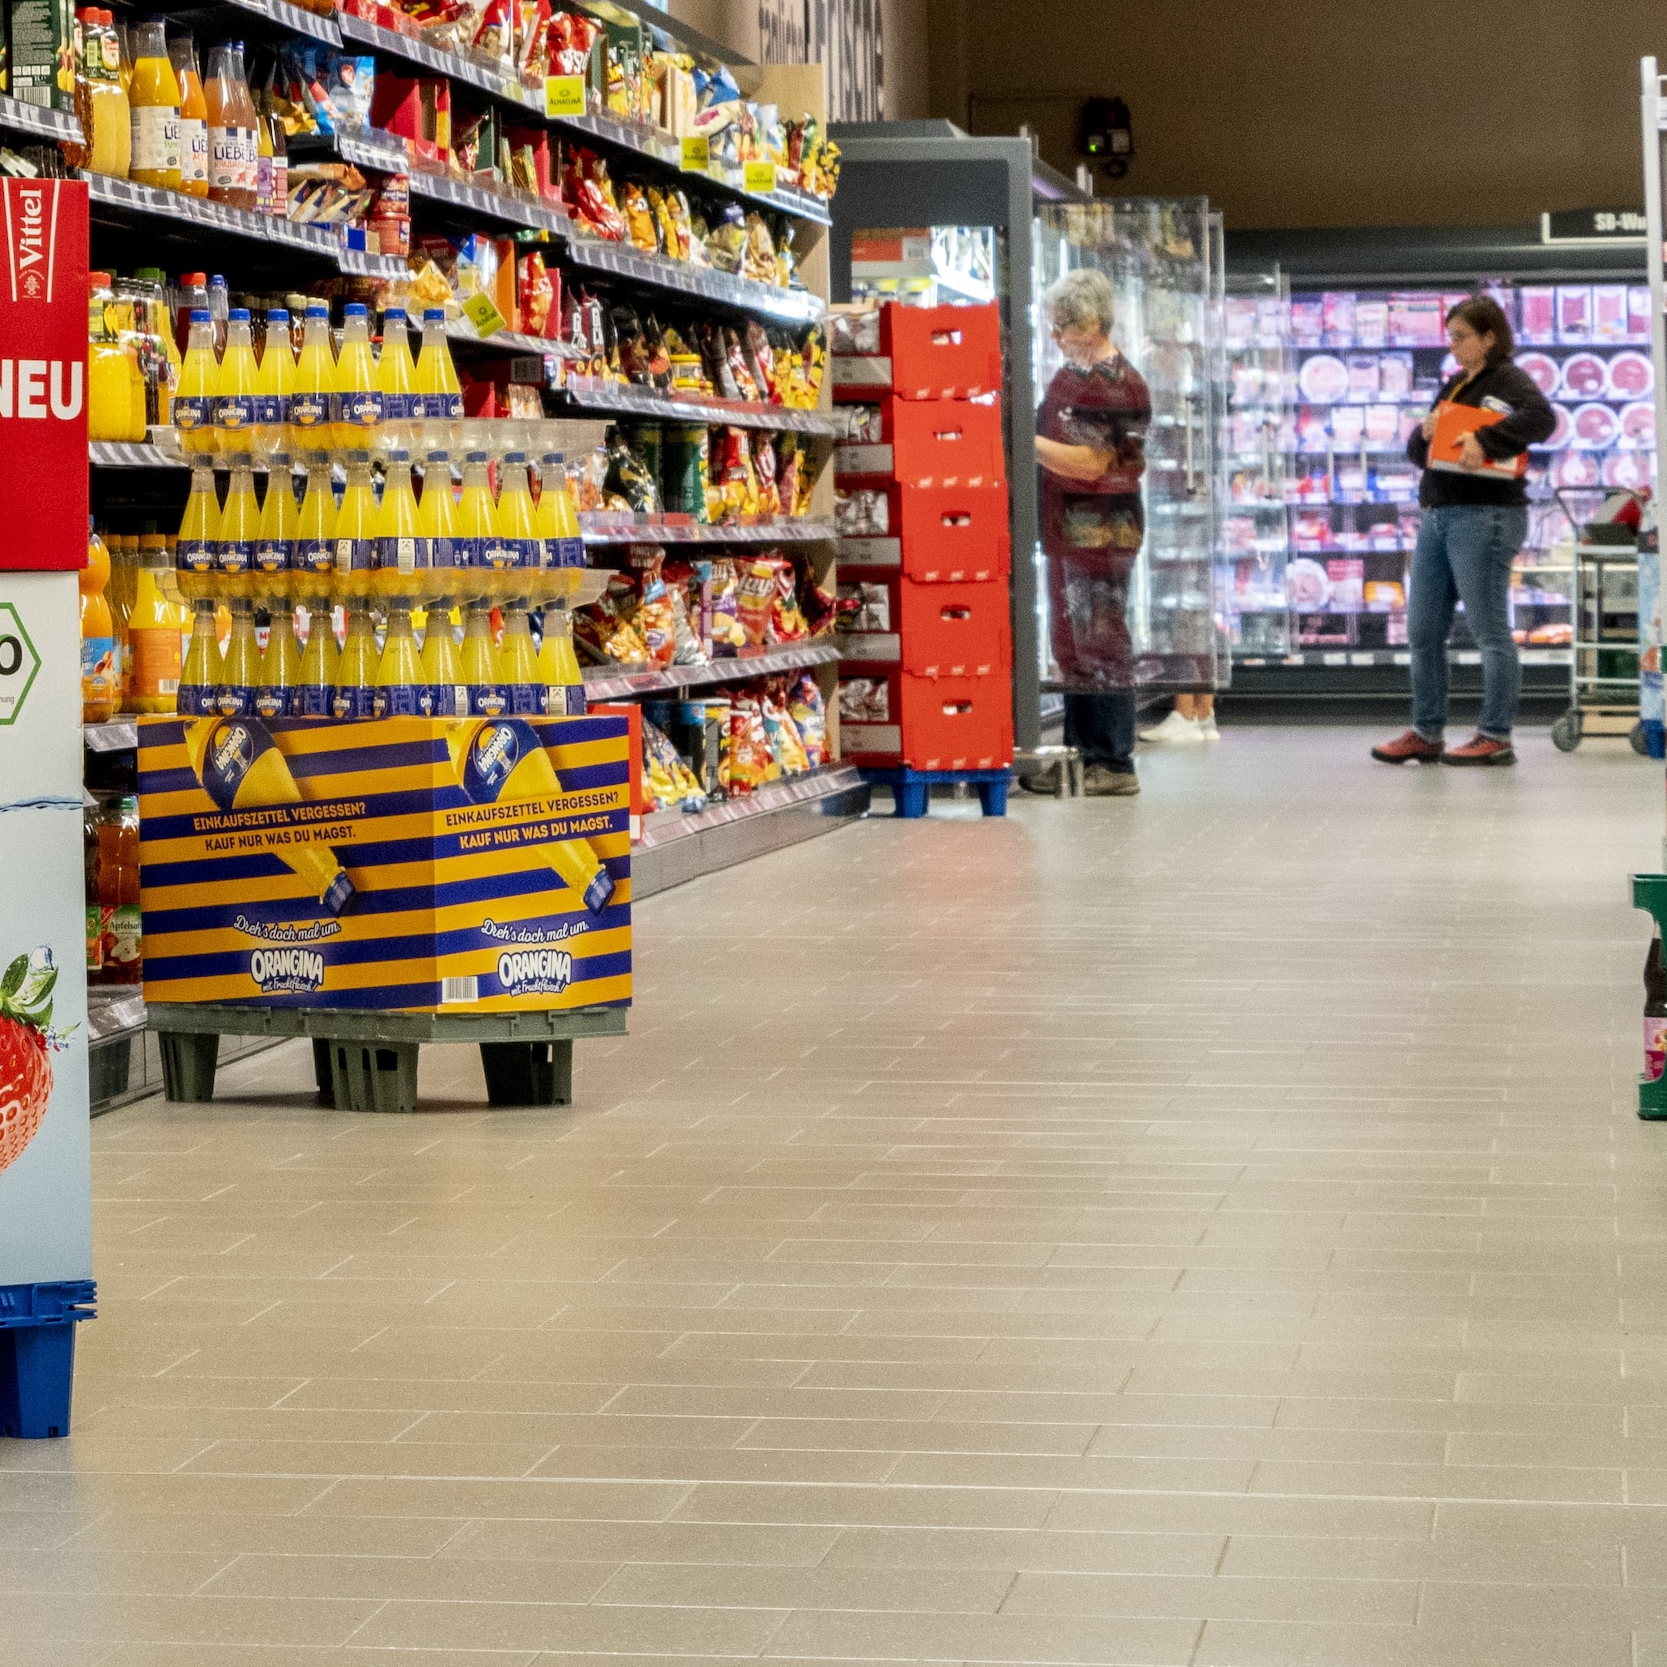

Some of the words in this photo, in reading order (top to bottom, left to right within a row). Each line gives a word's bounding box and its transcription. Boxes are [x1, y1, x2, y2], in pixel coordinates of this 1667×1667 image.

[19, 189, 43, 270] Vittel
[193, 809, 291, 832] EINKAUFSZETTEL
[291, 800, 367, 823] VERGESSEN?
[445, 802, 546, 828] EINKAUFSZETTEL
[546, 791, 620, 814] VERGESSEN?
[205, 835, 235, 852] KAUF
[237, 833, 264, 849] NUR
[265, 831, 293, 847] WAS
[294, 829, 312, 844] DU
[313, 825, 357, 843] MAGST.
[459, 832, 492, 850] KAUF
[493, 829, 520, 846] NUR
[522, 825, 550, 842] WAS
[550, 821, 568, 837] DU
[569, 814, 614, 835] MAGST.
[234, 914, 269, 939] Dreh's
[270, 924, 297, 942] doch
[297, 921, 320, 940] mal
[320, 920, 342, 937] um.
[481, 918, 517, 943] Dreh's
[517, 927, 546, 944] doch
[545, 923, 569, 942] mal
[569, 921, 590, 938] um.
[251, 949, 324, 981] ORANGINA
[499, 949, 573, 983] ORANGINA
